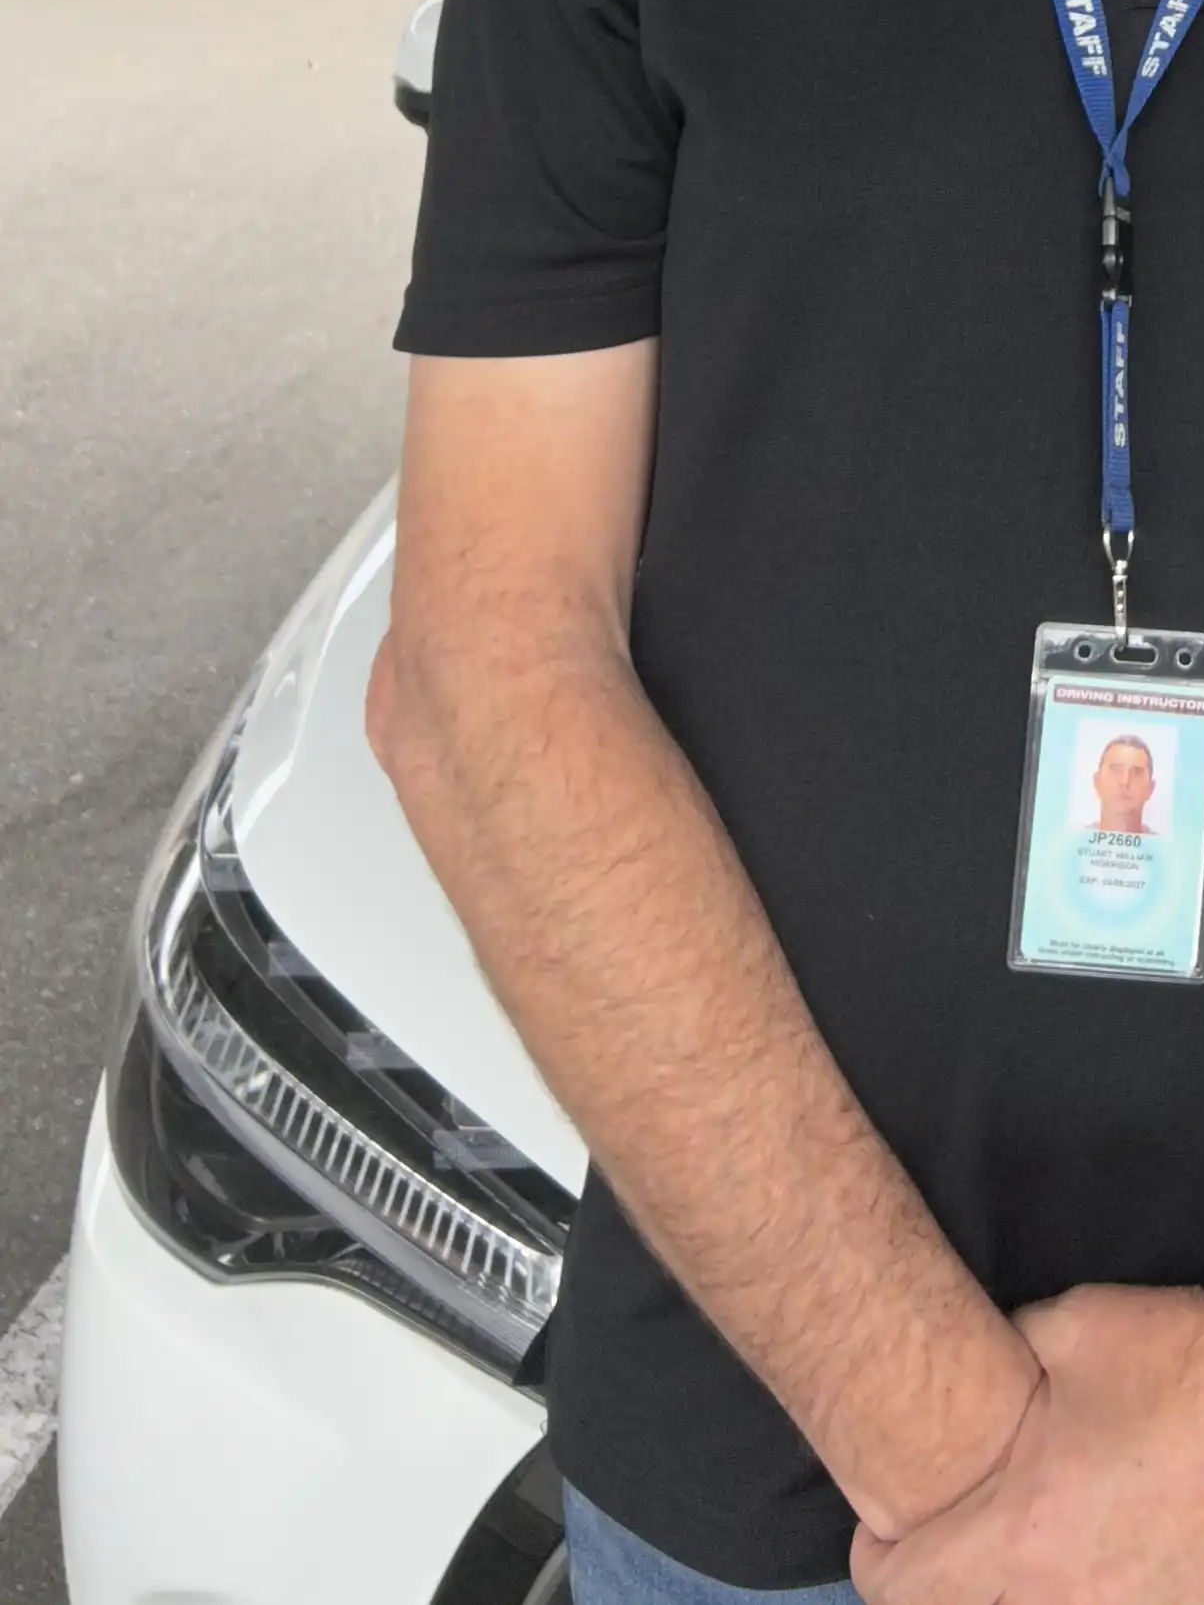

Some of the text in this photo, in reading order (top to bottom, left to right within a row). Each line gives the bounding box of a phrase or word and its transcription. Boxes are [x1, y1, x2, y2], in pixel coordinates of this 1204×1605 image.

[1114, 321, 1129, 447] STAFF
[1055, 687, 1114, 703] DRIVING
[1088, 832, 1142, 847] JP2660
